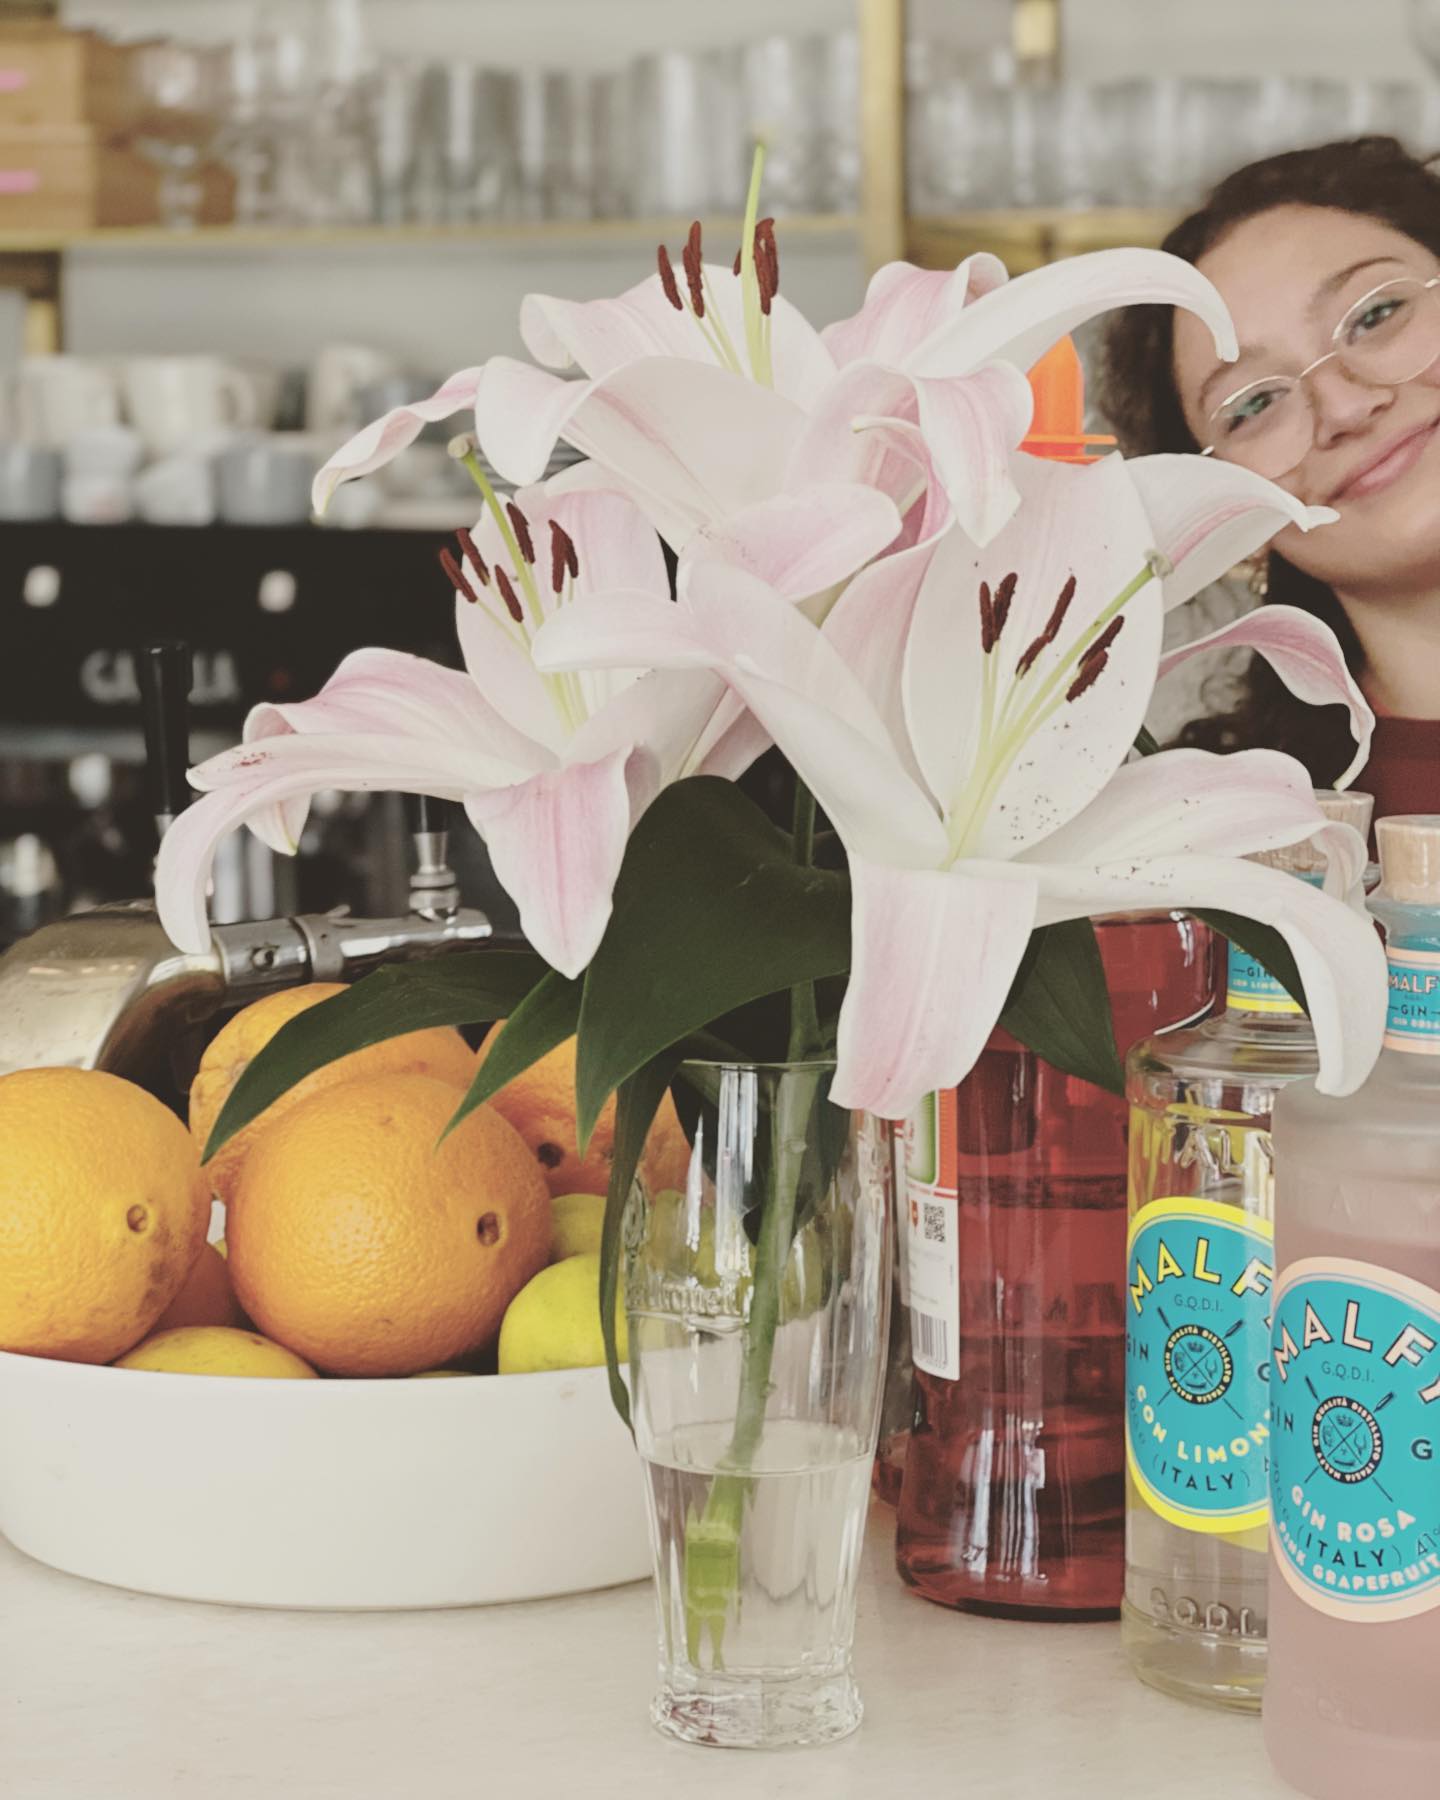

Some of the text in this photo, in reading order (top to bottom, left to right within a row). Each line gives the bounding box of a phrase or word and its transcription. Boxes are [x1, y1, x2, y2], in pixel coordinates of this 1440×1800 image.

[1388, 972, 1440, 995] MALF
[1400, 1004, 1427, 1017] GIN
[1129, 1236, 1272, 1330] MALF
[1173, 1293, 1223, 1312] G.Q.D.I.
[1321, 1360, 1375, 1383] G.Q.D.I.
[1136, 1384, 1270, 1465] CON LIMON
[1291, 1485, 1417, 1543] GIN ROSA
[1312, 1552, 1440, 1591] GRAPEFRUIT
